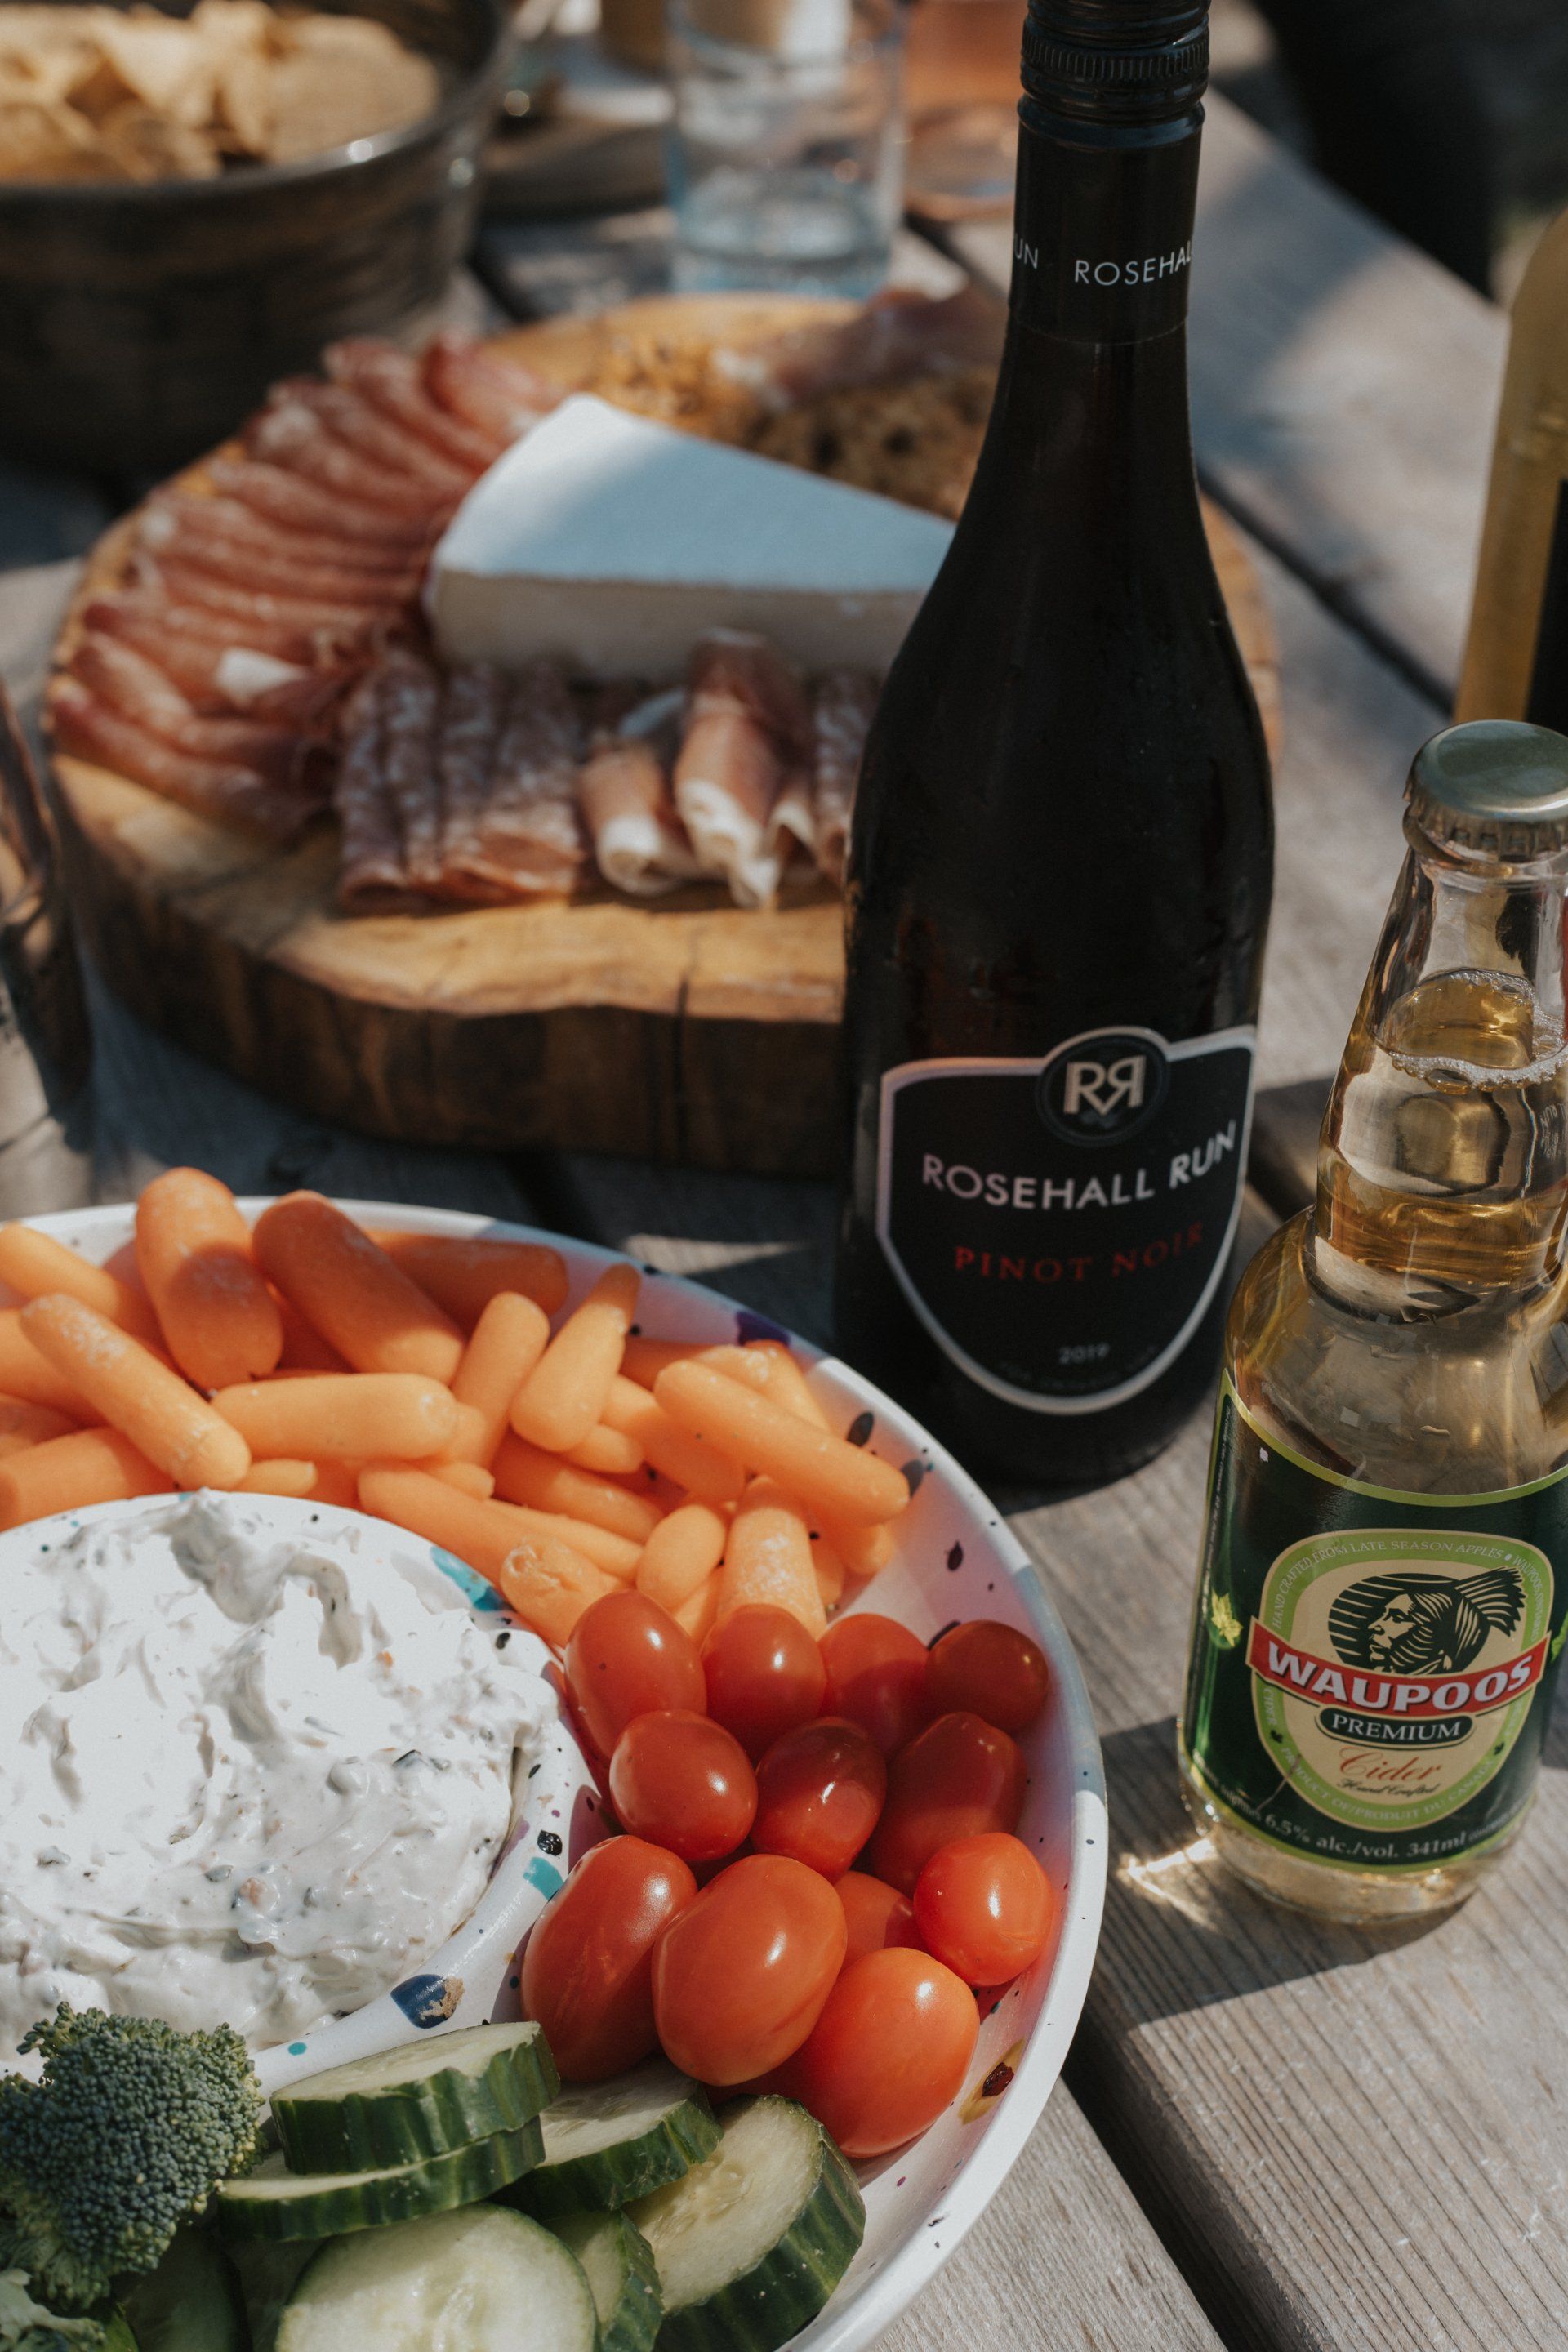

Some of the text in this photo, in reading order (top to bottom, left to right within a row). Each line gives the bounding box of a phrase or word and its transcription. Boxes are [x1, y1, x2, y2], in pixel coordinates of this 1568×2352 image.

[923, 1120, 1236, 1210] ROSEHALL RUN
[955, 1222, 1203, 1284] PINOT NOIR
[1059, 1343, 1111, 1365] 2019
[1272, 1595, 1285, 1629] HAND
[1279, 1557, 1312, 1594] CRAFTED
[1312, 1545, 1348, 1563] FROM
[1350, 1541, 1387, 1552] LATE
[1391, 1541, 1454, 1552] SEASON
[1456, 1544, 1504, 1559] APPLES
[1267, 1640, 1534, 1713] WAUPOOS
[1331, 1713, 1461, 1740] PREMIUM
[1339, 1746, 1442, 1780] Cider
[1265, 1814, 1311, 1843] 6.5%
[1316, 1836, 1398, 1858] alc./vol.
